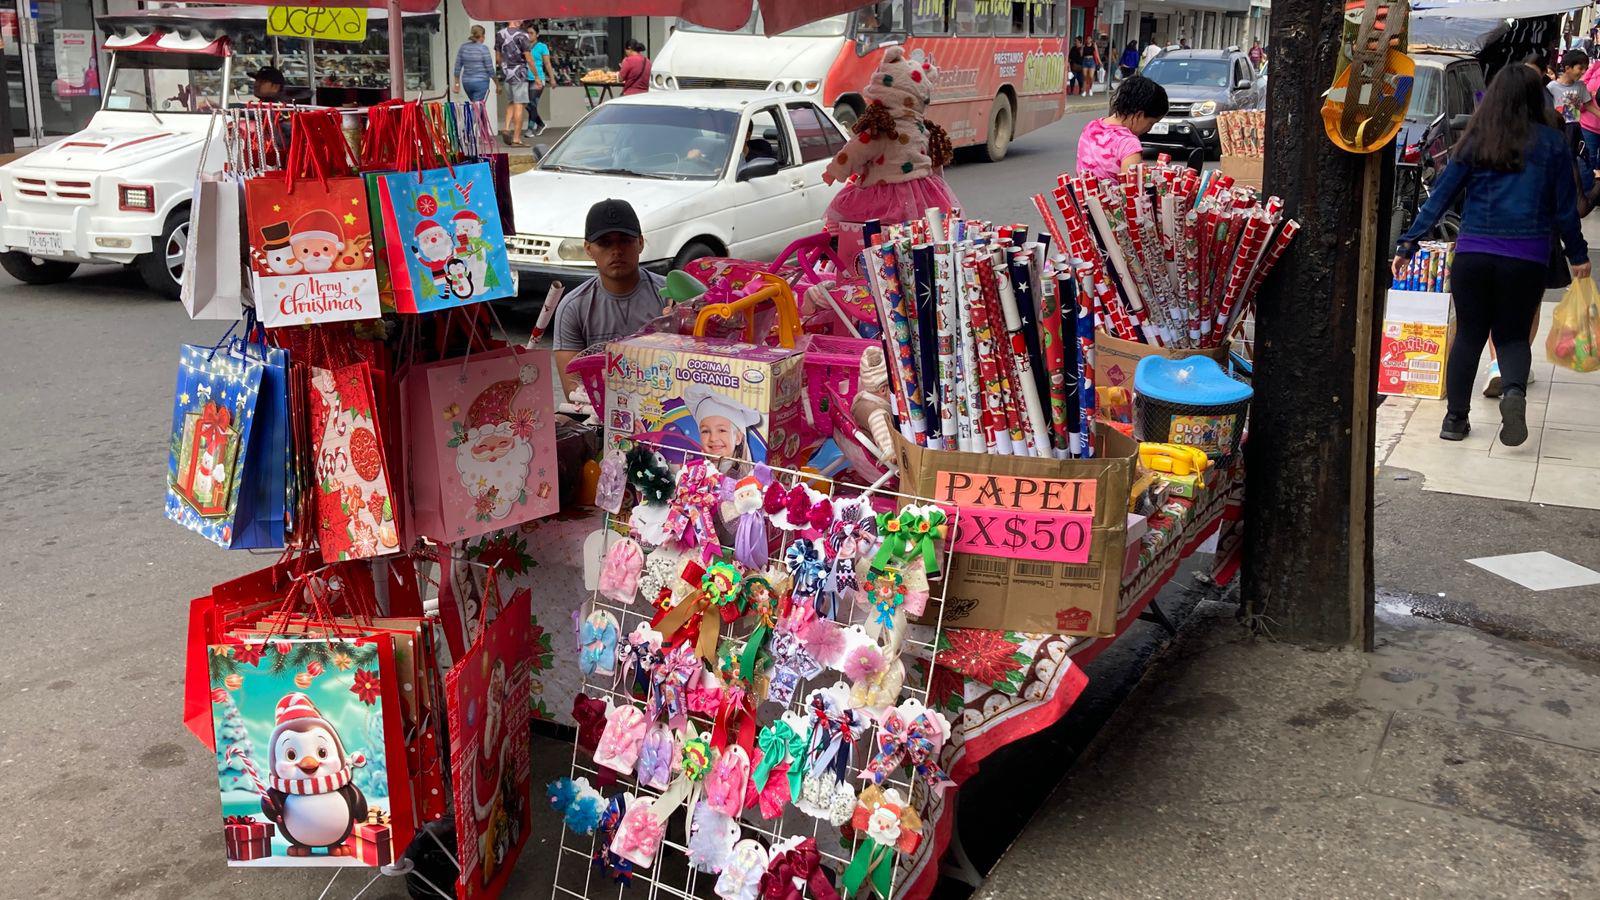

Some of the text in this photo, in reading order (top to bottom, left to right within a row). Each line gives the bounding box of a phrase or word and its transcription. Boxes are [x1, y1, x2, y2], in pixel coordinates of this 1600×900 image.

[306, 276, 347, 298] Merry
[280, 284, 362, 315] Christmas
[607, 351, 659, 381] Kitchen
[688, 359, 730, 373] COCINA A
[651, 375, 673, 389] Set
[676, 368, 692, 380] LO
[692, 370, 740, 388] GRANDE
[946, 472, 1093, 512] PAPEL
